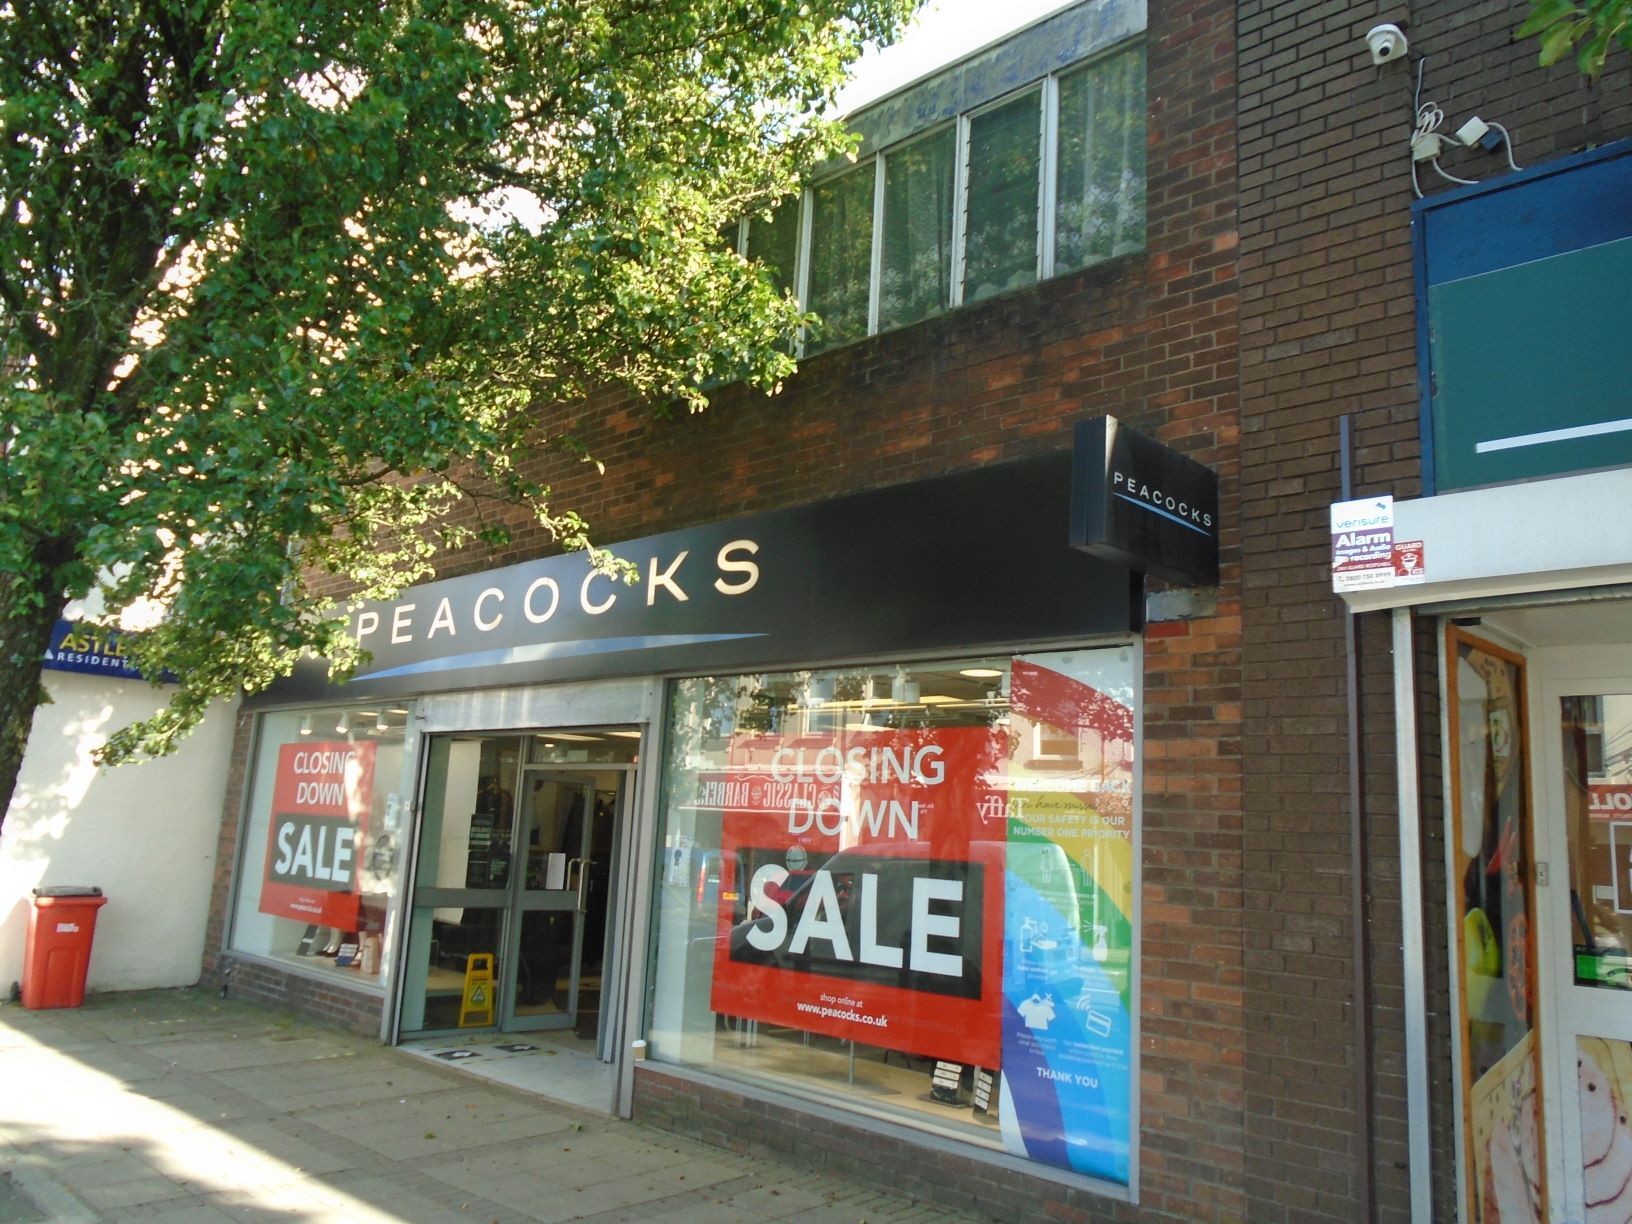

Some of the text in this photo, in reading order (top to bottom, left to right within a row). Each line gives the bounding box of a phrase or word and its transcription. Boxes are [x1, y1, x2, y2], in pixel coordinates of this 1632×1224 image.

[1113, 471, 1212, 527] PEACOCKS
[1336, 515, 1390, 529] verisure
[1336, 532, 1391, 548] Alarm
[1395, 542, 1422, 551] GUARD
[355, 539, 760, 648] PEACOCKS
[771, 744, 945, 787] CLOSING
[295, 782, 345, 806] DOWN
[787, 797, 919, 840] DOWN
[1049, 814, 1087, 825] SAFETY
[1103, 816, 1126, 826] OUR
[1013, 826, 1131, 839] NUMBER ONE PRIORITY
[274, 821, 355, 883] SALE
[746, 863, 964, 977] SALE
[820, 993, 864, 1008] shop online at
[797, 1002, 888, 1028] www.peacocks.co.uk
[1036, 1066, 1099, 1090] THANK YOU
